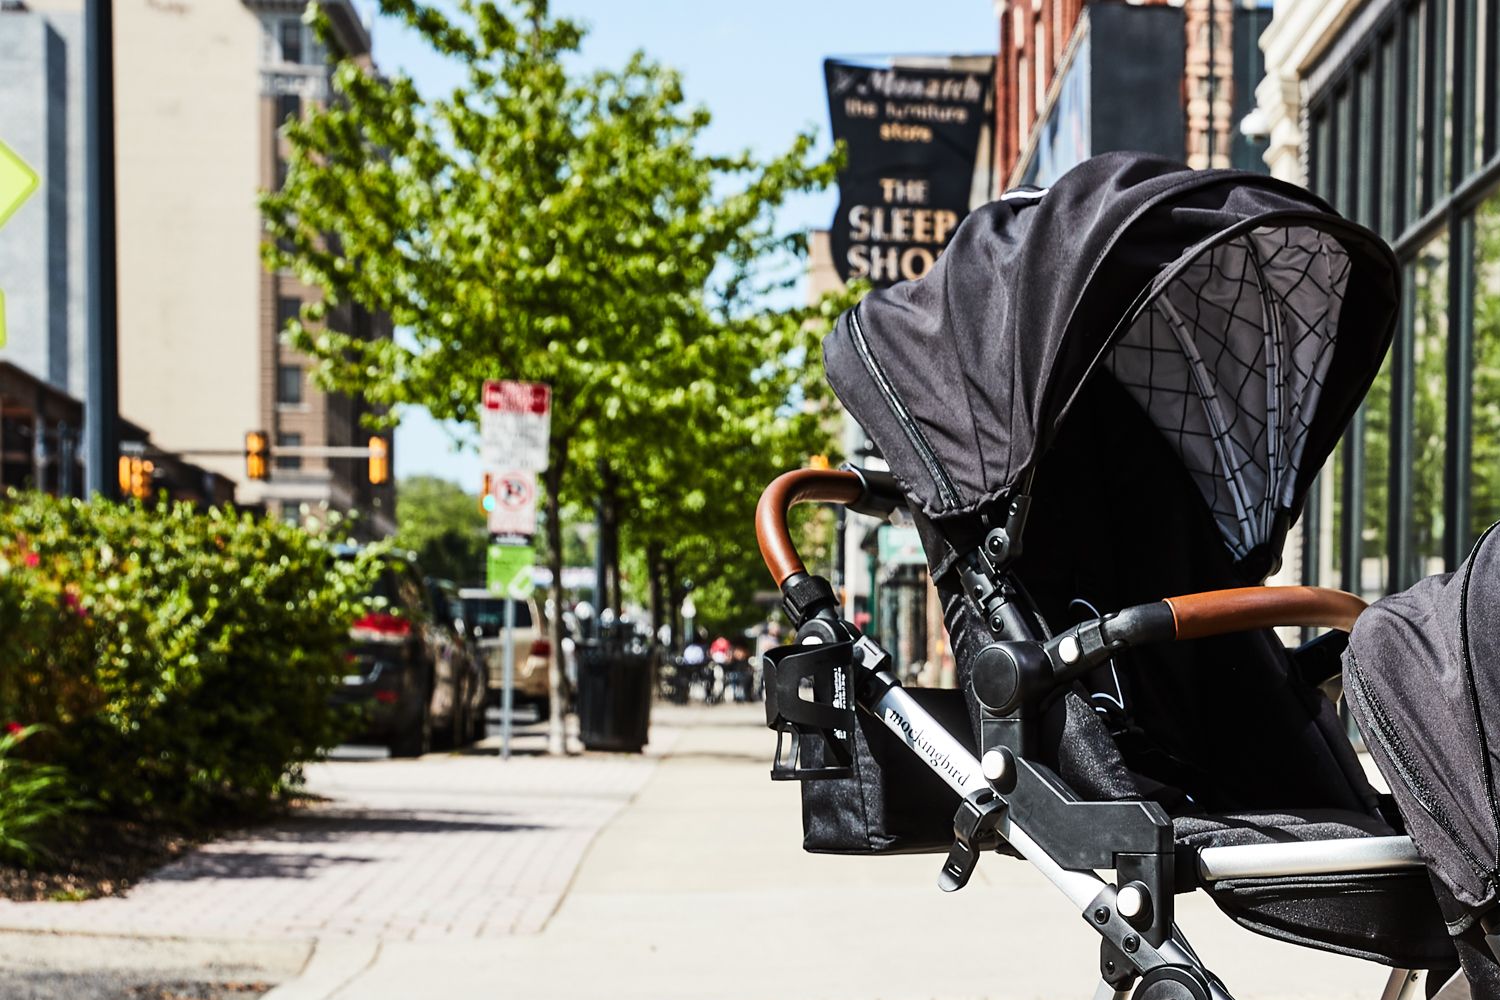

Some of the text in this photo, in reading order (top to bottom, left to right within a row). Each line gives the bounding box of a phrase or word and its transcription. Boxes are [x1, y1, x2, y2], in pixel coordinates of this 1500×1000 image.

[880, 179, 928, 203] THE
[848, 205, 958, 243] SLEEP
[846, 244, 943, 281] SHO
[889, 710, 970, 786] mockingbird
